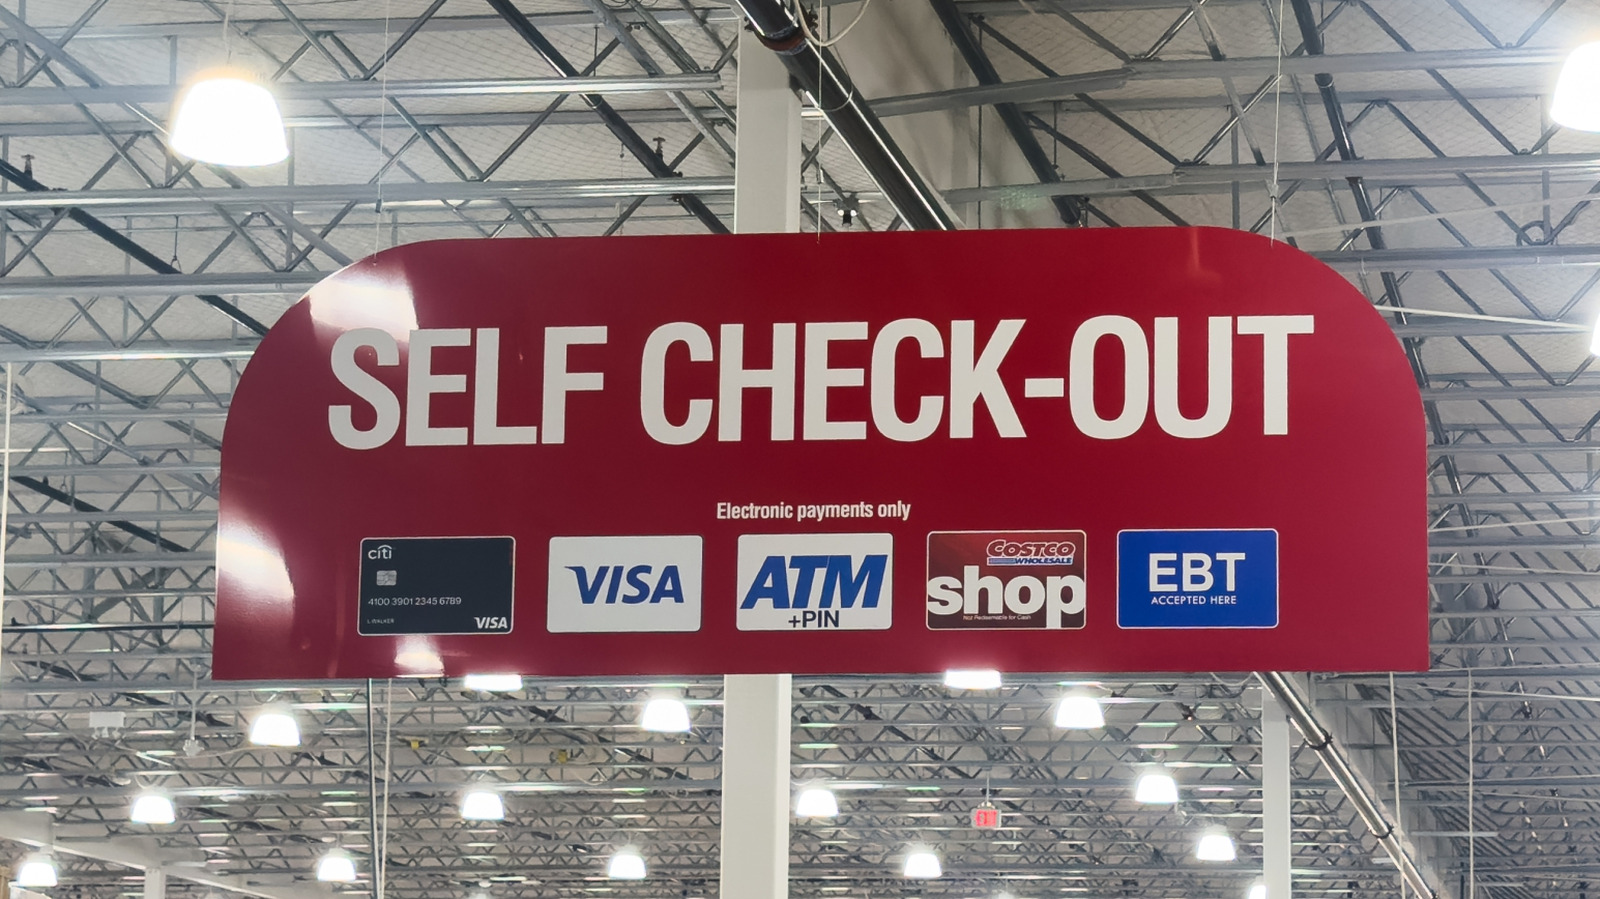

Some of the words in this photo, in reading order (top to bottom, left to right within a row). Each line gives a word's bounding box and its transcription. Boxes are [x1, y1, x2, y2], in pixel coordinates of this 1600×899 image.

[328, 326, 608, 450] SELF
[640, 315, 1315, 446] CHECK-OUT
[716, 501, 793, 519] Electronic
[797, 501, 873, 522] payments
[877, 500, 911, 521] only
[564, 565, 685, 604] VISA
[740, 555, 888, 609] ATM
[1149, 552, 1246, 592] EBT
[368, 597, 390, 606] 4100
[392, 597, 413, 606] 3901
[415, 597, 437, 606] 2345
[439, 596, 462, 605] 6789
[927, 565, 1086, 629] shop
[1151, 596, 1206, 605] ACCEPTED
[1211, 596, 1237, 605] HERE
[474, 616, 508, 629] VISA
[788, 610, 839, 628] +PIN
